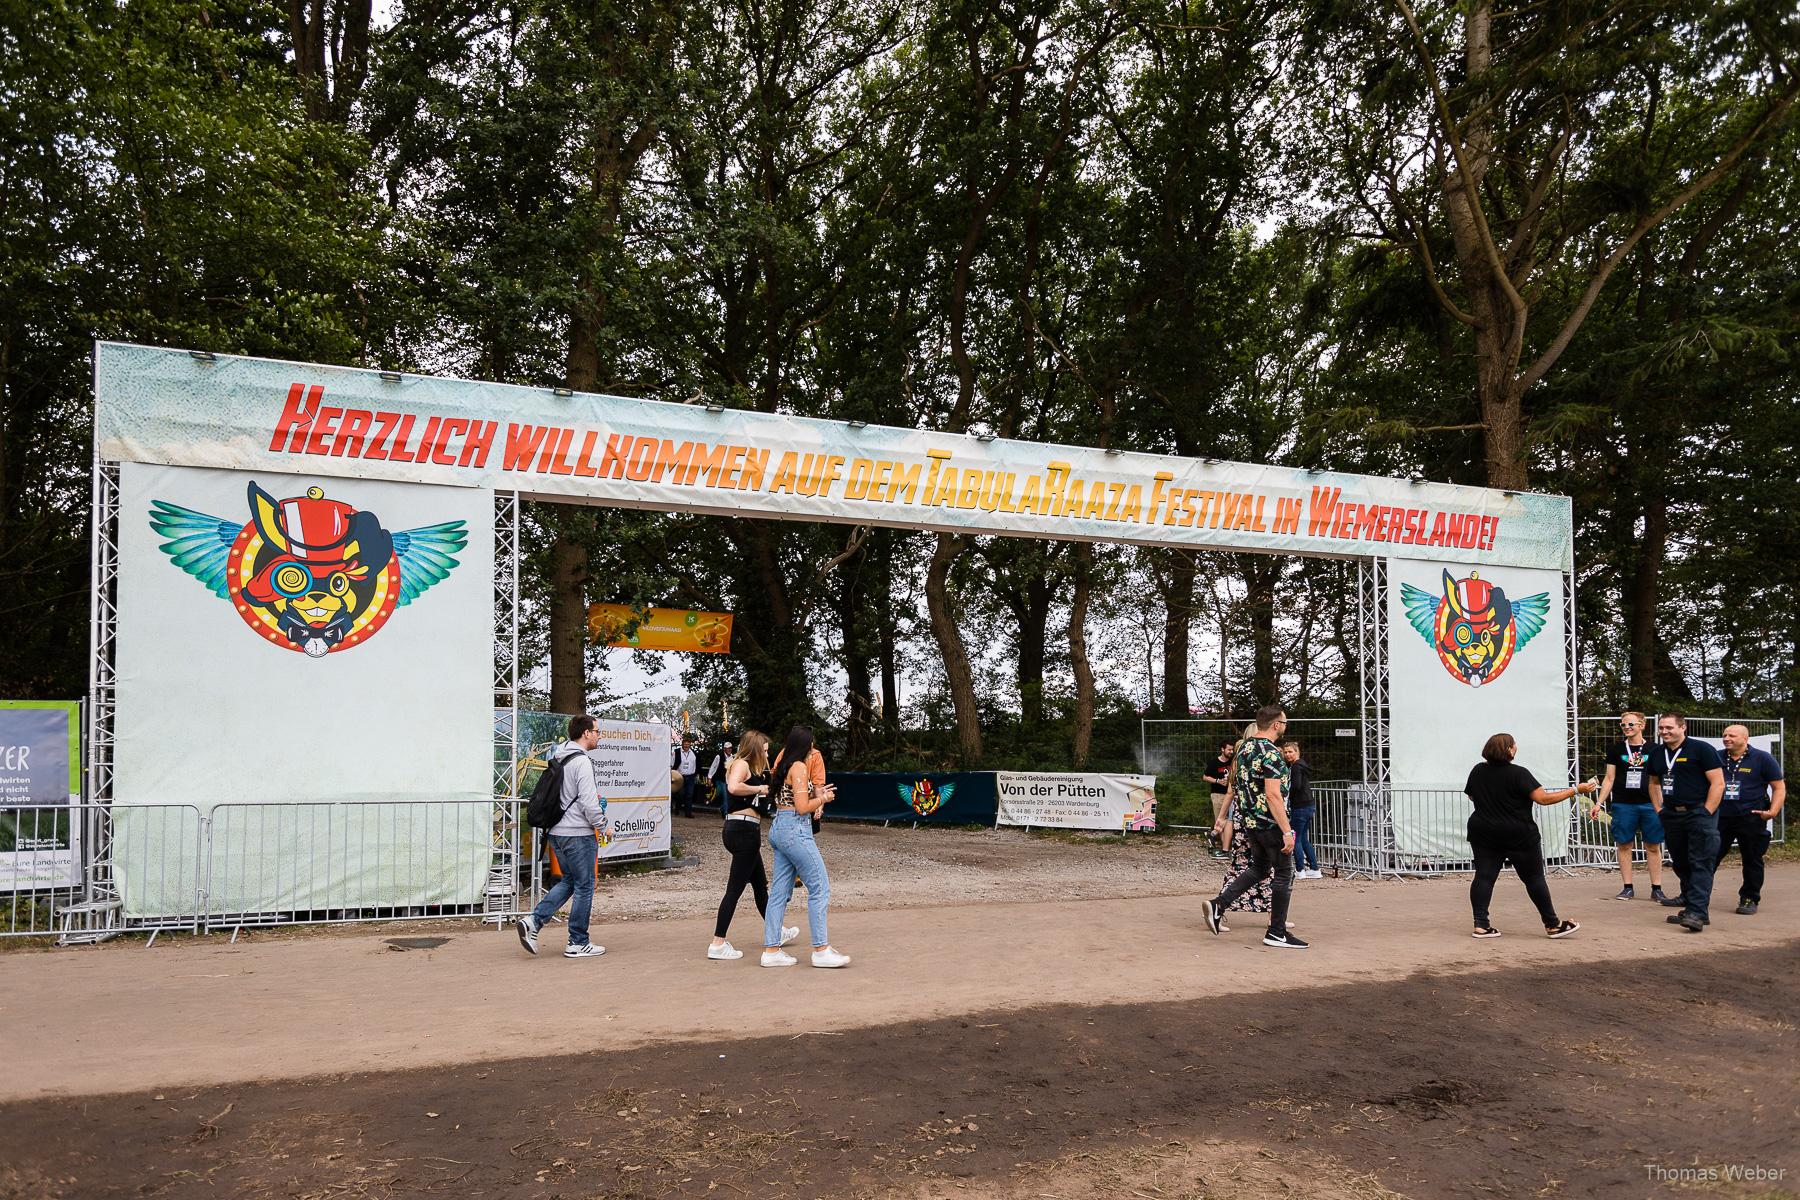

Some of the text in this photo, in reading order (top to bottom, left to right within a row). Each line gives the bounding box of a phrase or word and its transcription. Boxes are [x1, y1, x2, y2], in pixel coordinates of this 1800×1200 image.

[269, 383, 498, 468] HERZLICH
[503, 423, 770, 492] WILLKOMMEN
[768, 451, 845, 498] AUF
[843, 458, 922, 504] DEM
[1147, 472, 1266, 532] FESTIVAL
[1272, 497, 1303, 535] IN
[1308, 486, 1500, 551] WIEMERSLANDE!
[601, 729, 632, 740] suchen
[634, 729, 652, 741] Dich
[614, 779, 646, 788] Baumpfleger
[1028, 775, 1083, 783] Gebäudereinigung
[1000, 783, 1106, 797] Von der Pütten
[614, 819, 655, 832] Schelling
